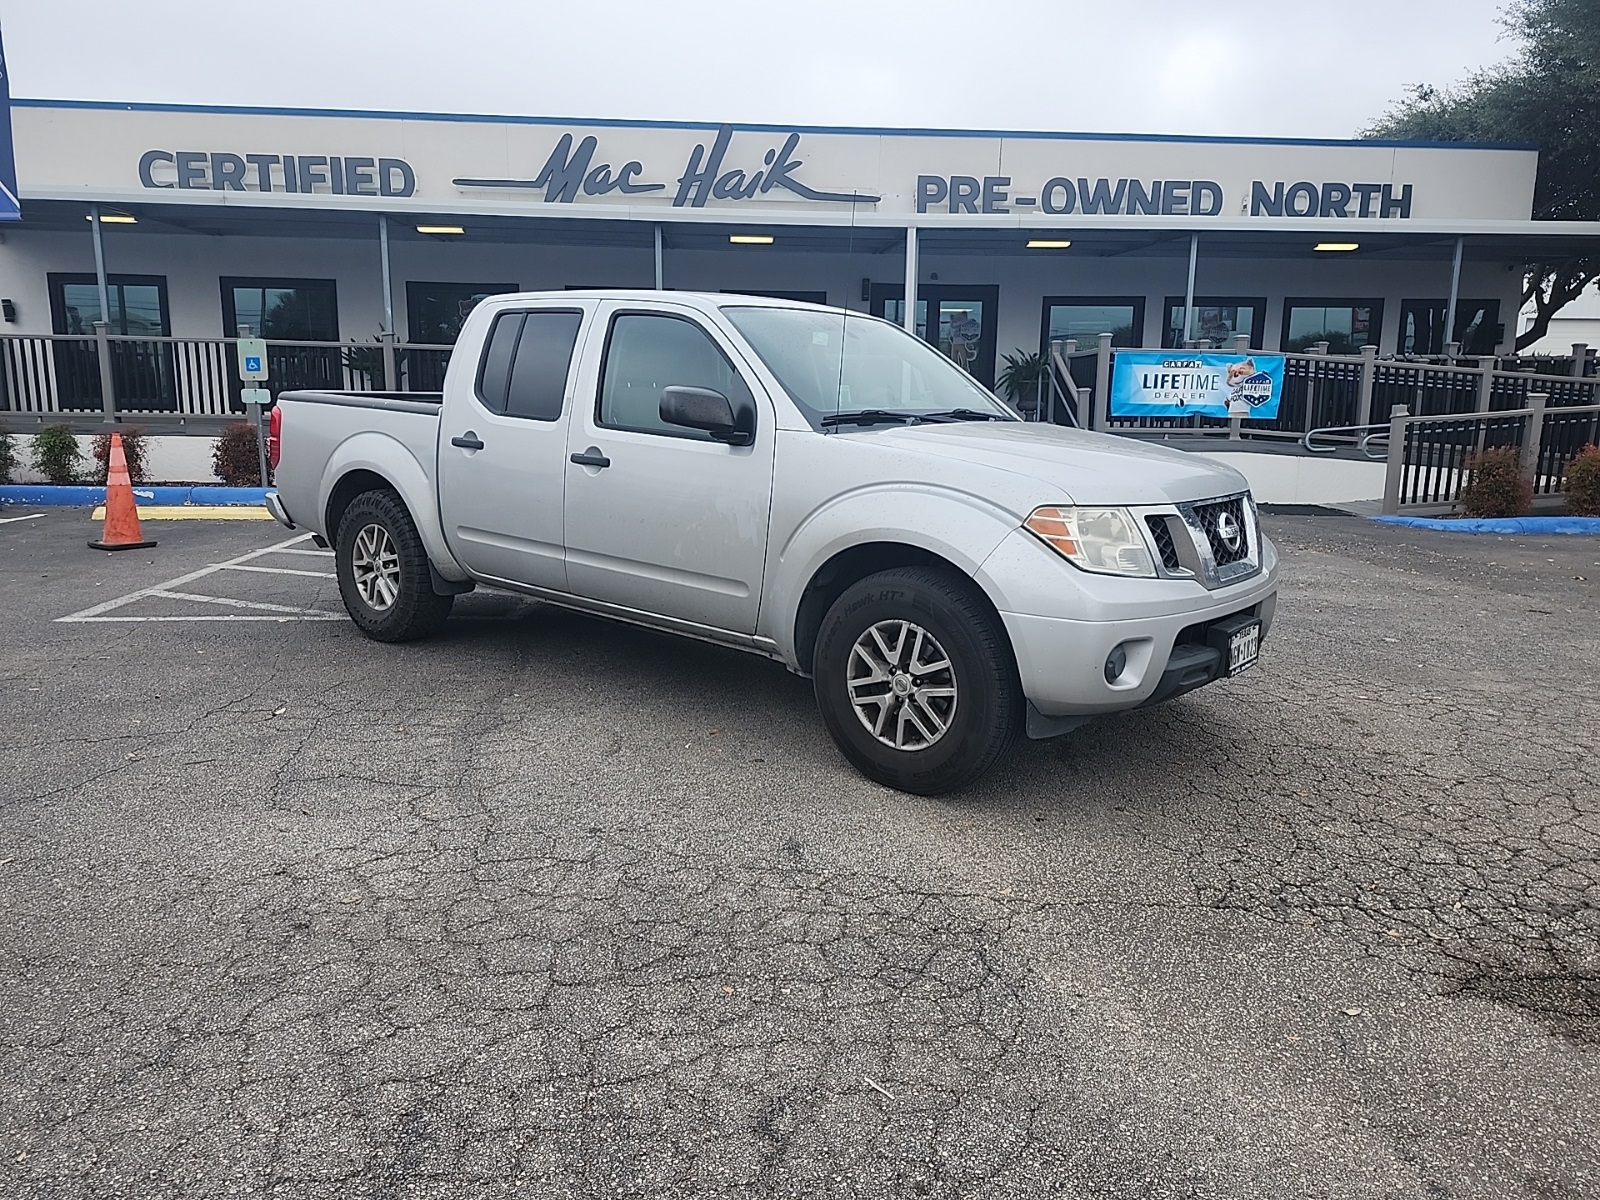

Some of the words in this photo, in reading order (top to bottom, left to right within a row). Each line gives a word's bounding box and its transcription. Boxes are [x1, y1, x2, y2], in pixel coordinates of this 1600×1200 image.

[138, 149, 417, 197] CERTIFIED
[453, 133, 665, 203] Mac
[673, 124, 881, 207] Haik
[916, 174, 1223, 216] PRE-OWNED
[1251, 180, 1414, 219] NORTH
[1143, 374, 1220, 390] LIFETIME
